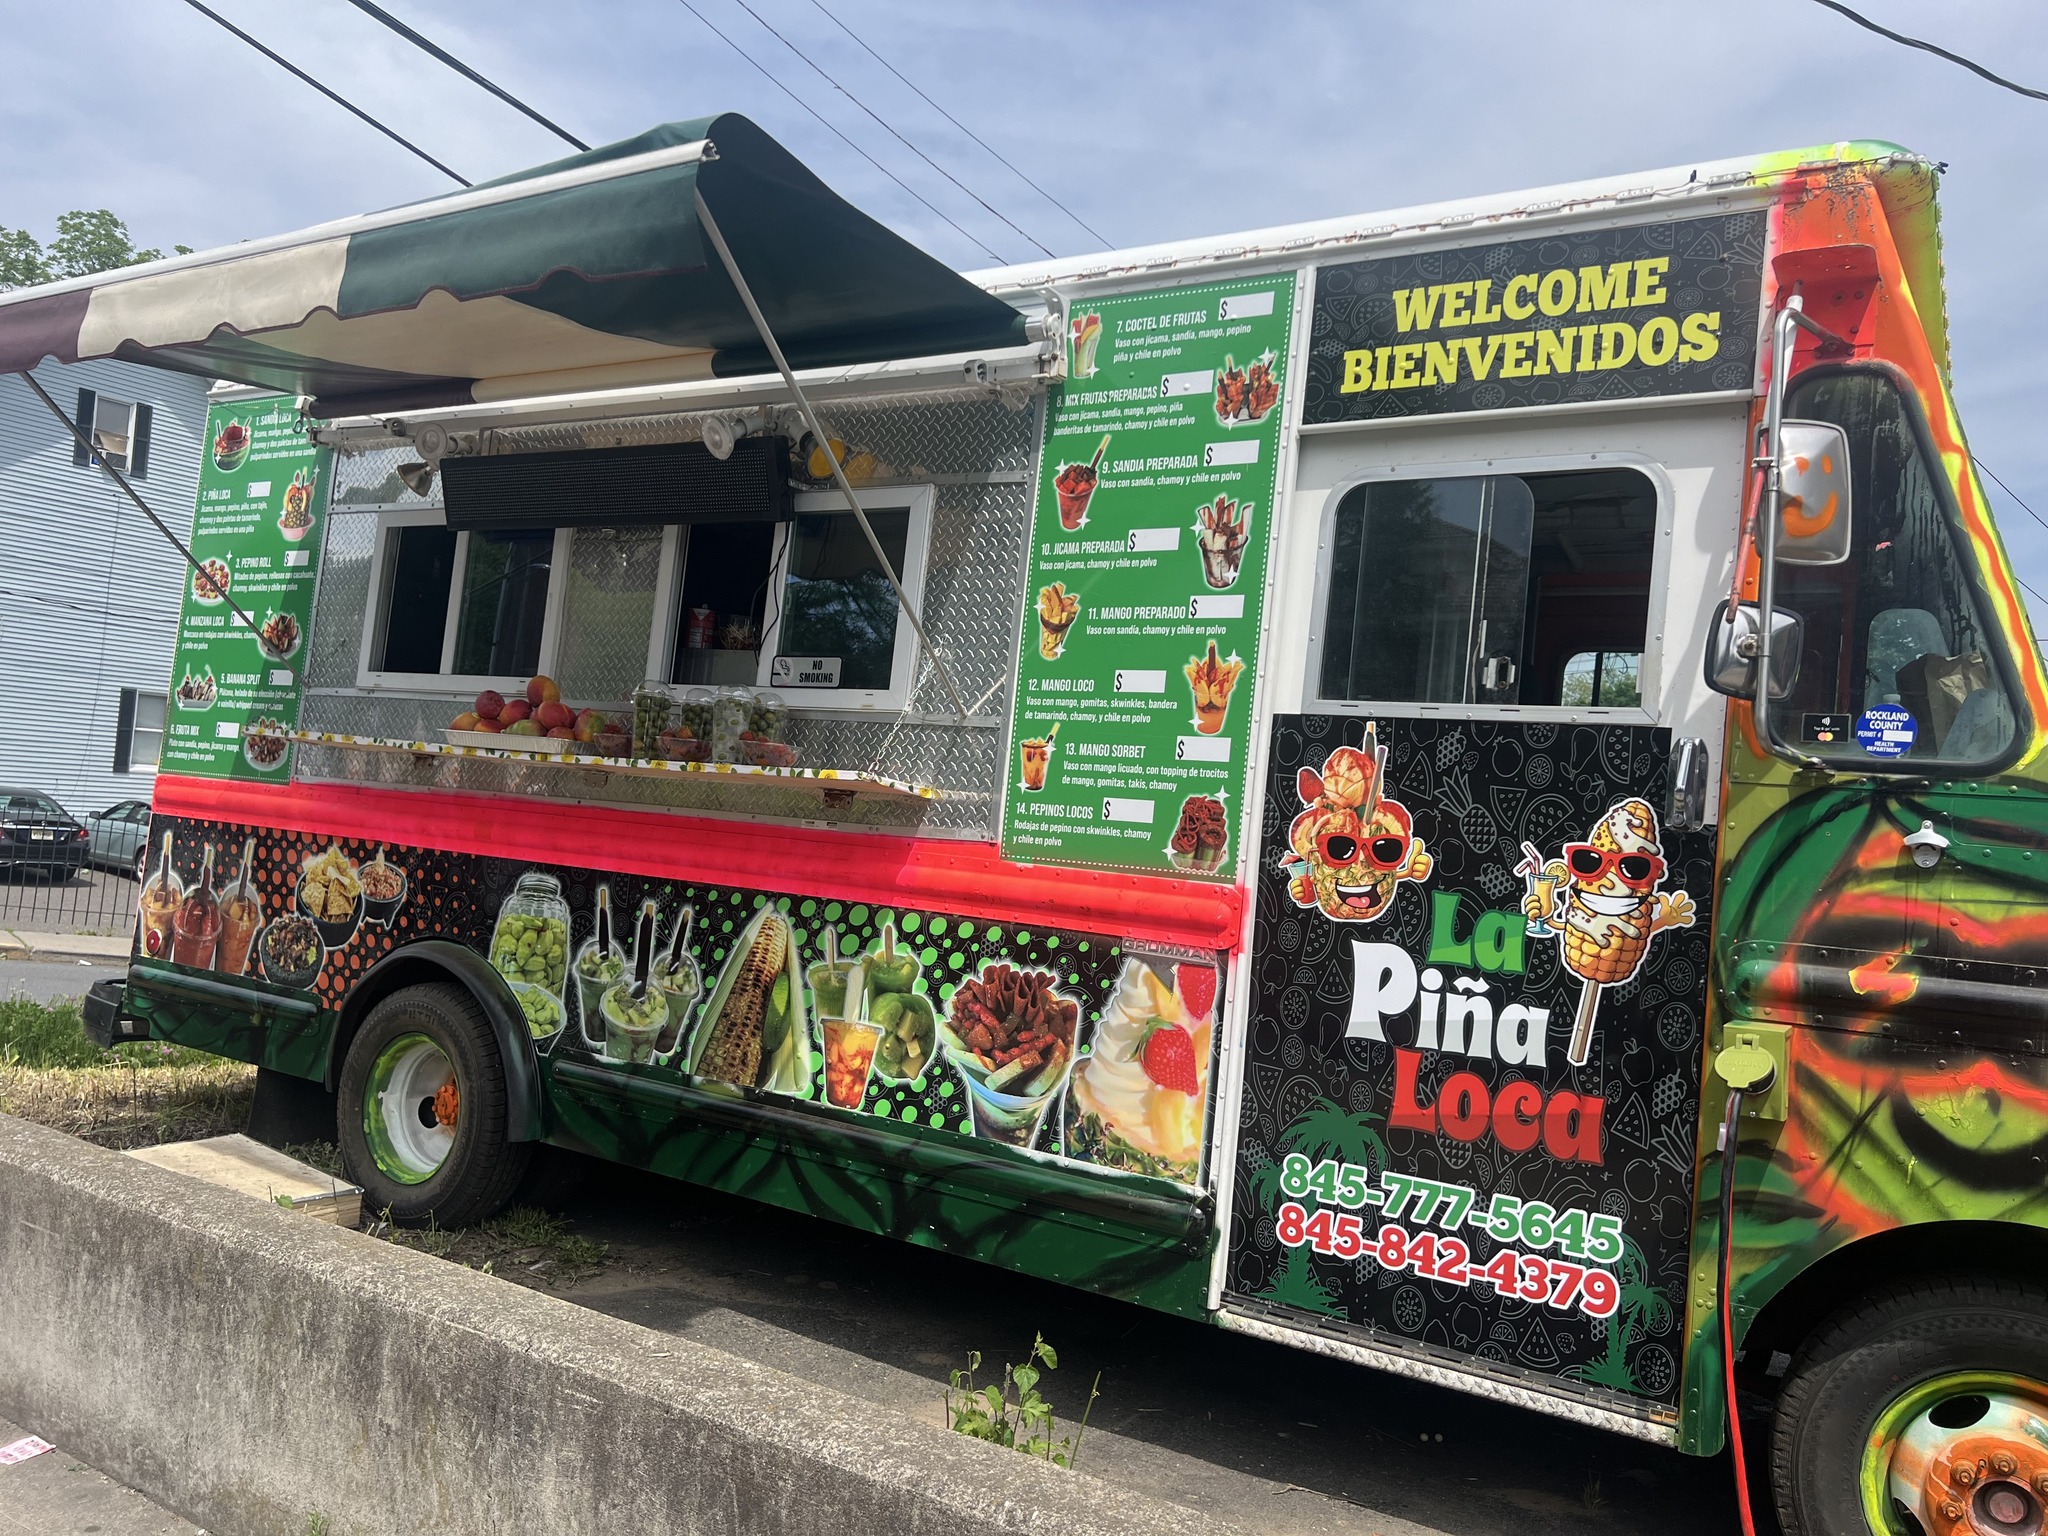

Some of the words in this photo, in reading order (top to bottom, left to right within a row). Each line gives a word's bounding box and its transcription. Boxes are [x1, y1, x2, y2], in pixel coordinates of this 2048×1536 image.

[1393, 257, 1669, 332] WELCOME
[1117, 321, 1123, 333] 7.
[1125, 317, 1157, 332] COCTEL
[1160, 315, 1170, 328] DE
[1173, 311, 1207, 326] FRUTAS
[1220, 301, 1227, 320] $
[1115, 338, 1130, 348] Vaso
[1132, 338, 1144, 346] con
[1172, 330, 1196, 341] sandía,
[1199, 328, 1224, 339] mango,
[1226, 324, 1251, 338] pepino
[1114, 352, 1127, 364] piña
[1129, 352, 1133, 362] y
[1135, 349, 1151, 359] chile
[1162, 347, 1181, 359] polvo
[1340, 311, 1720, 393] BIENVENIDOS
[1057, 395, 1063, 406] 8.
[1065, 393, 1079, 406] MIX
[1081, 391, 1107, 404] FRUTAS
[1162, 378, 1169, 396] $
[1054, 425, 1083, 435] banderitas
[1084, 424, 1091, 433] de
[1092, 422, 1123, 432] tamarindo,
[1125, 420, 1147, 430] chamoy
[1148, 421, 1152, 430] y
[1154, 418, 1168, 427] chile
[1178, 416, 1195, 427] polvo
[1102, 461, 1110, 473] 9.
[1113, 459, 1143, 473] SANDIA
[1146, 455, 1198, 470] PREPARADA
[1206, 447, 1213, 465] $
[1101, 479, 1116, 488] Vaso
[1131, 477, 1155, 486] sandía,
[1157, 476, 1184, 486] chamoy
[1185, 476, 1190, 486] y
[1192, 473, 1209, 483] chile
[1220, 472, 1241, 484] polvo
[219, 490, 230, 500] LOCA
[1042, 544, 1051, 555] 10.
[1053, 542, 1080, 555] JICAMA
[1082, 540, 1124, 553] PREPARADA
[1129, 533, 1136, 550] $
[236, 558, 240, 568] 3.
[241, 558, 258, 568] PEPINO
[259, 557, 271, 567] ROLL
[1040, 561, 1052, 569] Vaso
[1087, 559, 1110, 570] chamoy
[1111, 561, 1115, 570] y
[1117, 558, 1130, 567] chile
[1140, 557, 1157, 569] polvo
[1088, 608, 1098, 619] 11.
[1101, 607, 1132, 619] MANGO
[1134, 607, 1185, 619] PREPARADO
[1191, 599, 1197, 618] $
[191, 616, 212, 626] MANZANA
[213, 616, 224, 626] LOCA
[1086, 625, 1101, 634] Vaso
[1117, 625, 1141, 635] sandía,
[1143, 625, 1169, 637] chamoy
[1171, 627, 1176, 637] y
[1177, 625, 1194, 634] chile
[1206, 625, 1226, 636] polvo
[812, 660, 823, 671] NO
[221, 674, 225, 684] 5.
[226, 674, 245, 684] BANANA
[247, 674, 261, 684] SPLIT
[799, 672, 833, 684] SMOKING
[1028, 679, 1039, 690] 12.
[1041, 679, 1070, 691] MANGO
[1073, 679, 1094, 691] LOCO
[1116, 673, 1122, 691] $
[1027, 696, 1040, 705] Vaso
[1056, 699, 1077, 709] mango,
[1081, 698, 1108, 709] gomitas,
[1111, 698, 1146, 709] skwinkles,
[1149, 699, 1177, 709] bandera
[1025, 710, 1032, 719] de
[1034, 710, 1068, 721] tamarindo,
[1070, 712, 1097, 723] chamoy,
[1099, 714, 1103, 724] y
[1104, 712, 1120, 721] chile
[1132, 713, 1151, 724] polvo
[1865, 711, 1909, 720] ROCKLAND
[190, 725, 200, 735] MIX
[1870, 720, 1903, 730] COUNTY
[1065, 743, 1076, 755] 13.
[1079, 744, 1109, 757] MANGO
[1112, 745, 1145, 758] SORBET
[1178, 740, 1184, 759] $
[1064, 760, 1078, 770] Vaso
[1094, 764, 1116, 775] mango
[1118, 763, 1144, 775] licuado,
[1160, 766, 1187, 778] topping
[1189, 767, 1198, 776] de
[1200, 768, 1228, 778] trocitos
[1062, 774, 1070, 784] de
[1072, 777, 1096, 788] mango,
[1098, 777, 1127, 788] gomitas,
[1129, 778, 1147, 789] takis,
[1149, 779, 1177, 792] chamoy
[1016, 802, 1027, 814] 14.
[1030, 803, 1064, 817] PEPINOS
[1066, 806, 1093, 819] LOCOS
[1104, 801, 1111, 819] $
[1015, 820, 1039, 833] Rodajas
[1041, 822, 1048, 831] de
[1050, 823, 1072, 834] pepino
[1087, 825, 1122, 837] skwinkles,
[1124, 828, 1151, 840] chamoy
[1013, 836, 1017, 845] y
[1019, 835, 1033, 843] chile
[1044, 837, 1062, 847] polvo
[1427, 889, 1530, 974] La
[1122, 938, 1216, 962] GRUMMAN
[1344, 938, 1551, 1068] Piña
[1388, 1047, 1606, 1167] Loca
[1280, 1153, 1624, 1262] 845-777-5645
[1276, 1205, 1620, 1319] 845-842-4379
